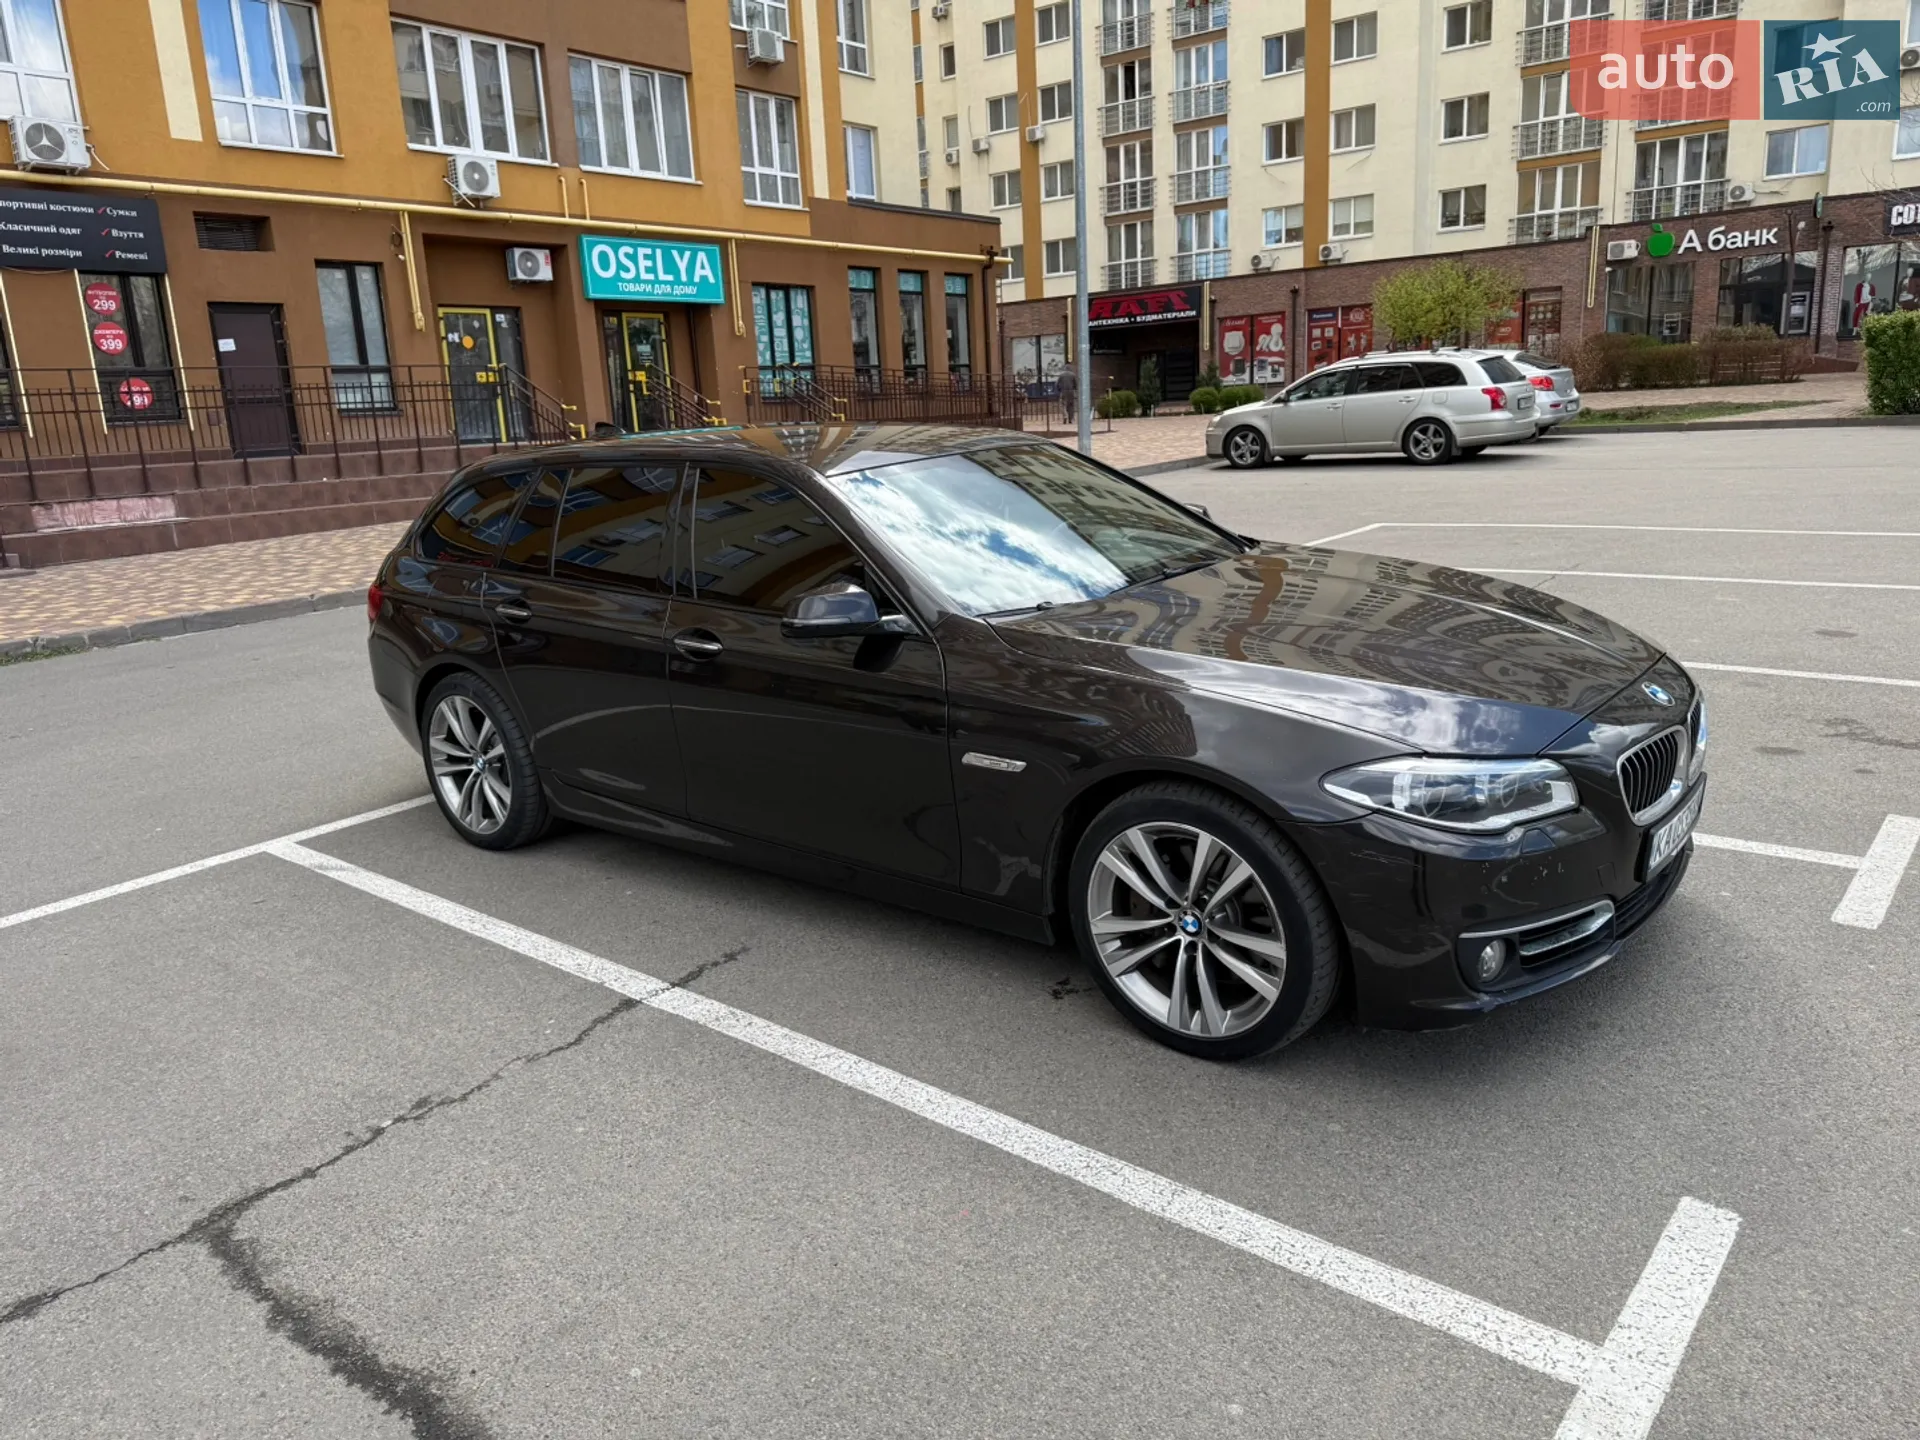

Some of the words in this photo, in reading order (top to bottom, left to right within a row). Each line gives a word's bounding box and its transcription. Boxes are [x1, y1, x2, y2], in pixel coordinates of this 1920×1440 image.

[0, 200, 47, 210] портивні
[49, 203, 94, 213] костюми
[106, 207, 137, 217] Сумки
[0, 222, 57, 233] Класичний
[60, 227, 82, 236] одяг
[111, 229, 144, 239] Взуття
[1678, 229, 1702, 255] А
[1708, 226, 1778, 251] банк
[2, 245, 39, 255] Великі
[41, 248, 83, 259] розміри
[115, 251, 148, 260] Ремені
[592, 244, 715, 284] OSELYA
[618, 283, 652, 292] ТОВАРИ
[654, 285, 672, 294] ДЛЯ
[673, 286, 697, 296] ДОМУ
[94, 300, 116, 310] 299
[1088, 317, 1129, 327] АНТЕХНІКА
[1136, 311, 1197, 322] БУДМАТЕРІАЛИ
[100, 339, 123, 350] 399
